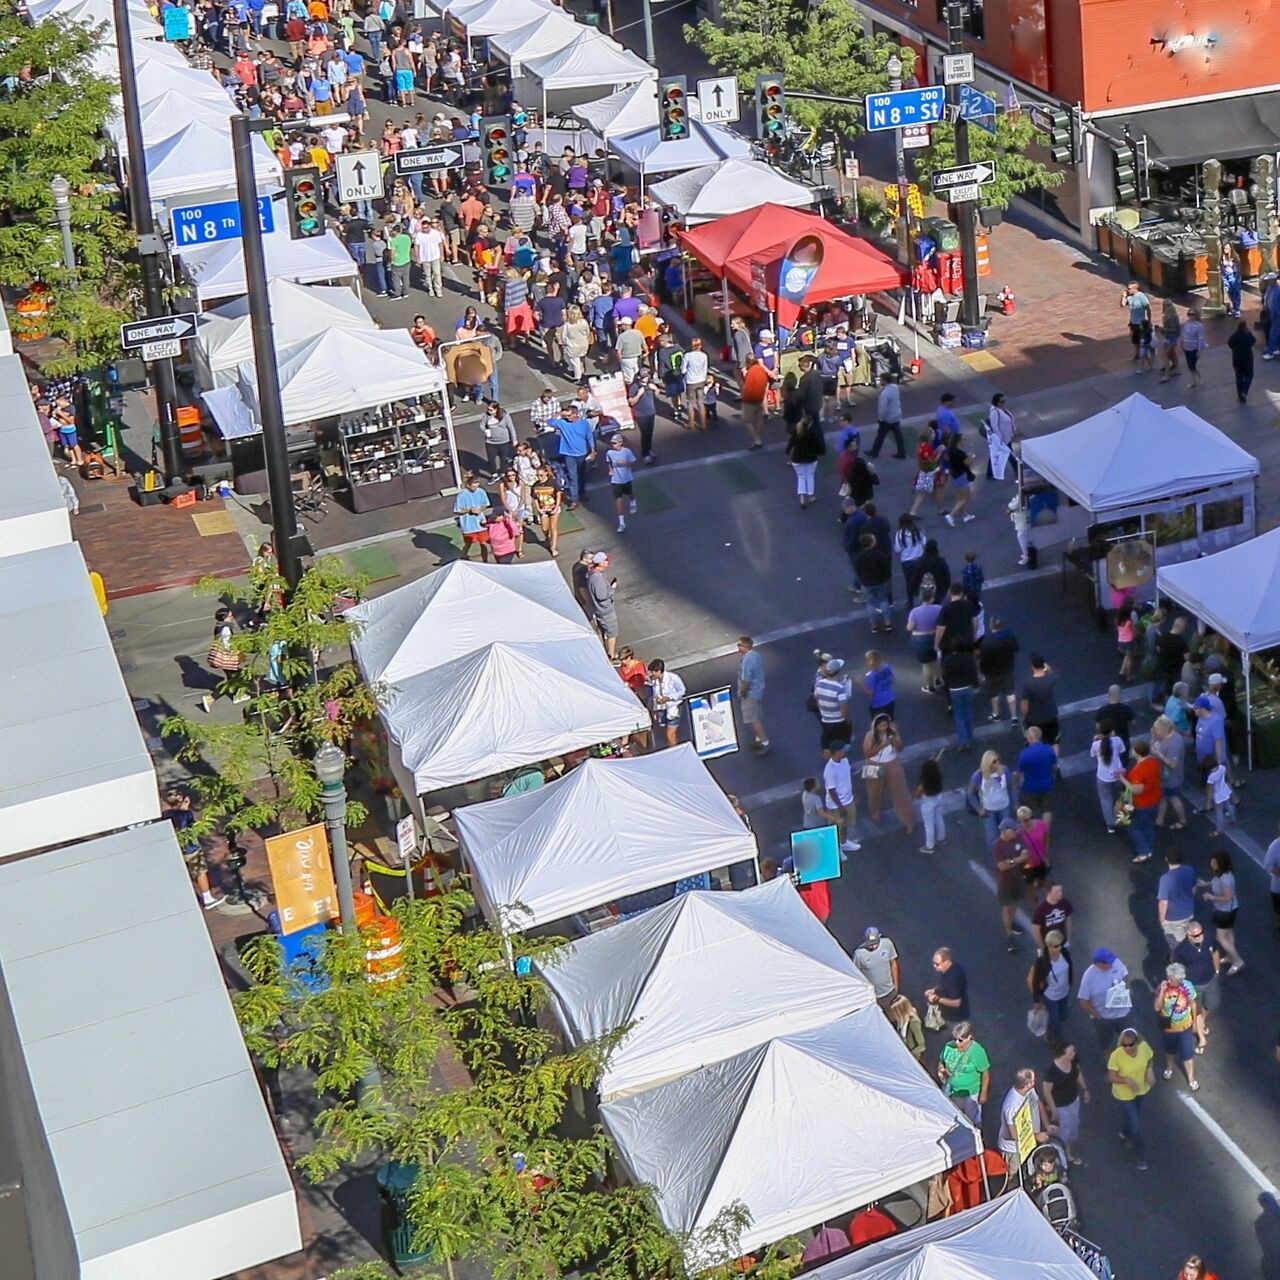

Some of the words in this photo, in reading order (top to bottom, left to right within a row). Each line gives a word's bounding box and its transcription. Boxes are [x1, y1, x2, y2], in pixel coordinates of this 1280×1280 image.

[947, 71, 971, 80] ENFORCED
[874, 96, 891, 107] 100
[920, 90, 938, 101] 200
[706, 108, 733, 120] ONLY
[873, 109, 886, 126] N
[890, 107, 901, 124] 8
[904, 105, 916, 115] Th
[920, 102, 939, 120] St
[403, 156, 422, 166] ONE
[426, 153, 445, 164] WAY
[935, 173, 955, 185] ONE
[956, 171, 975, 181] WAY
[346, 185, 378, 198] ONLY
[954, 186, 974, 195] EXCEPT
[952, 193, 976, 202] BICYCLES
[180, 209, 202, 220] 100
[182, 223, 197, 242] N
[203, 220, 217, 239] 8
[221, 217, 236, 228] Th
[130, 328, 150, 339] ONE
[155, 324, 175, 334] WAY
[149, 342, 174, 352] EXCEPT
[146, 348, 178, 359] BICYCLES
